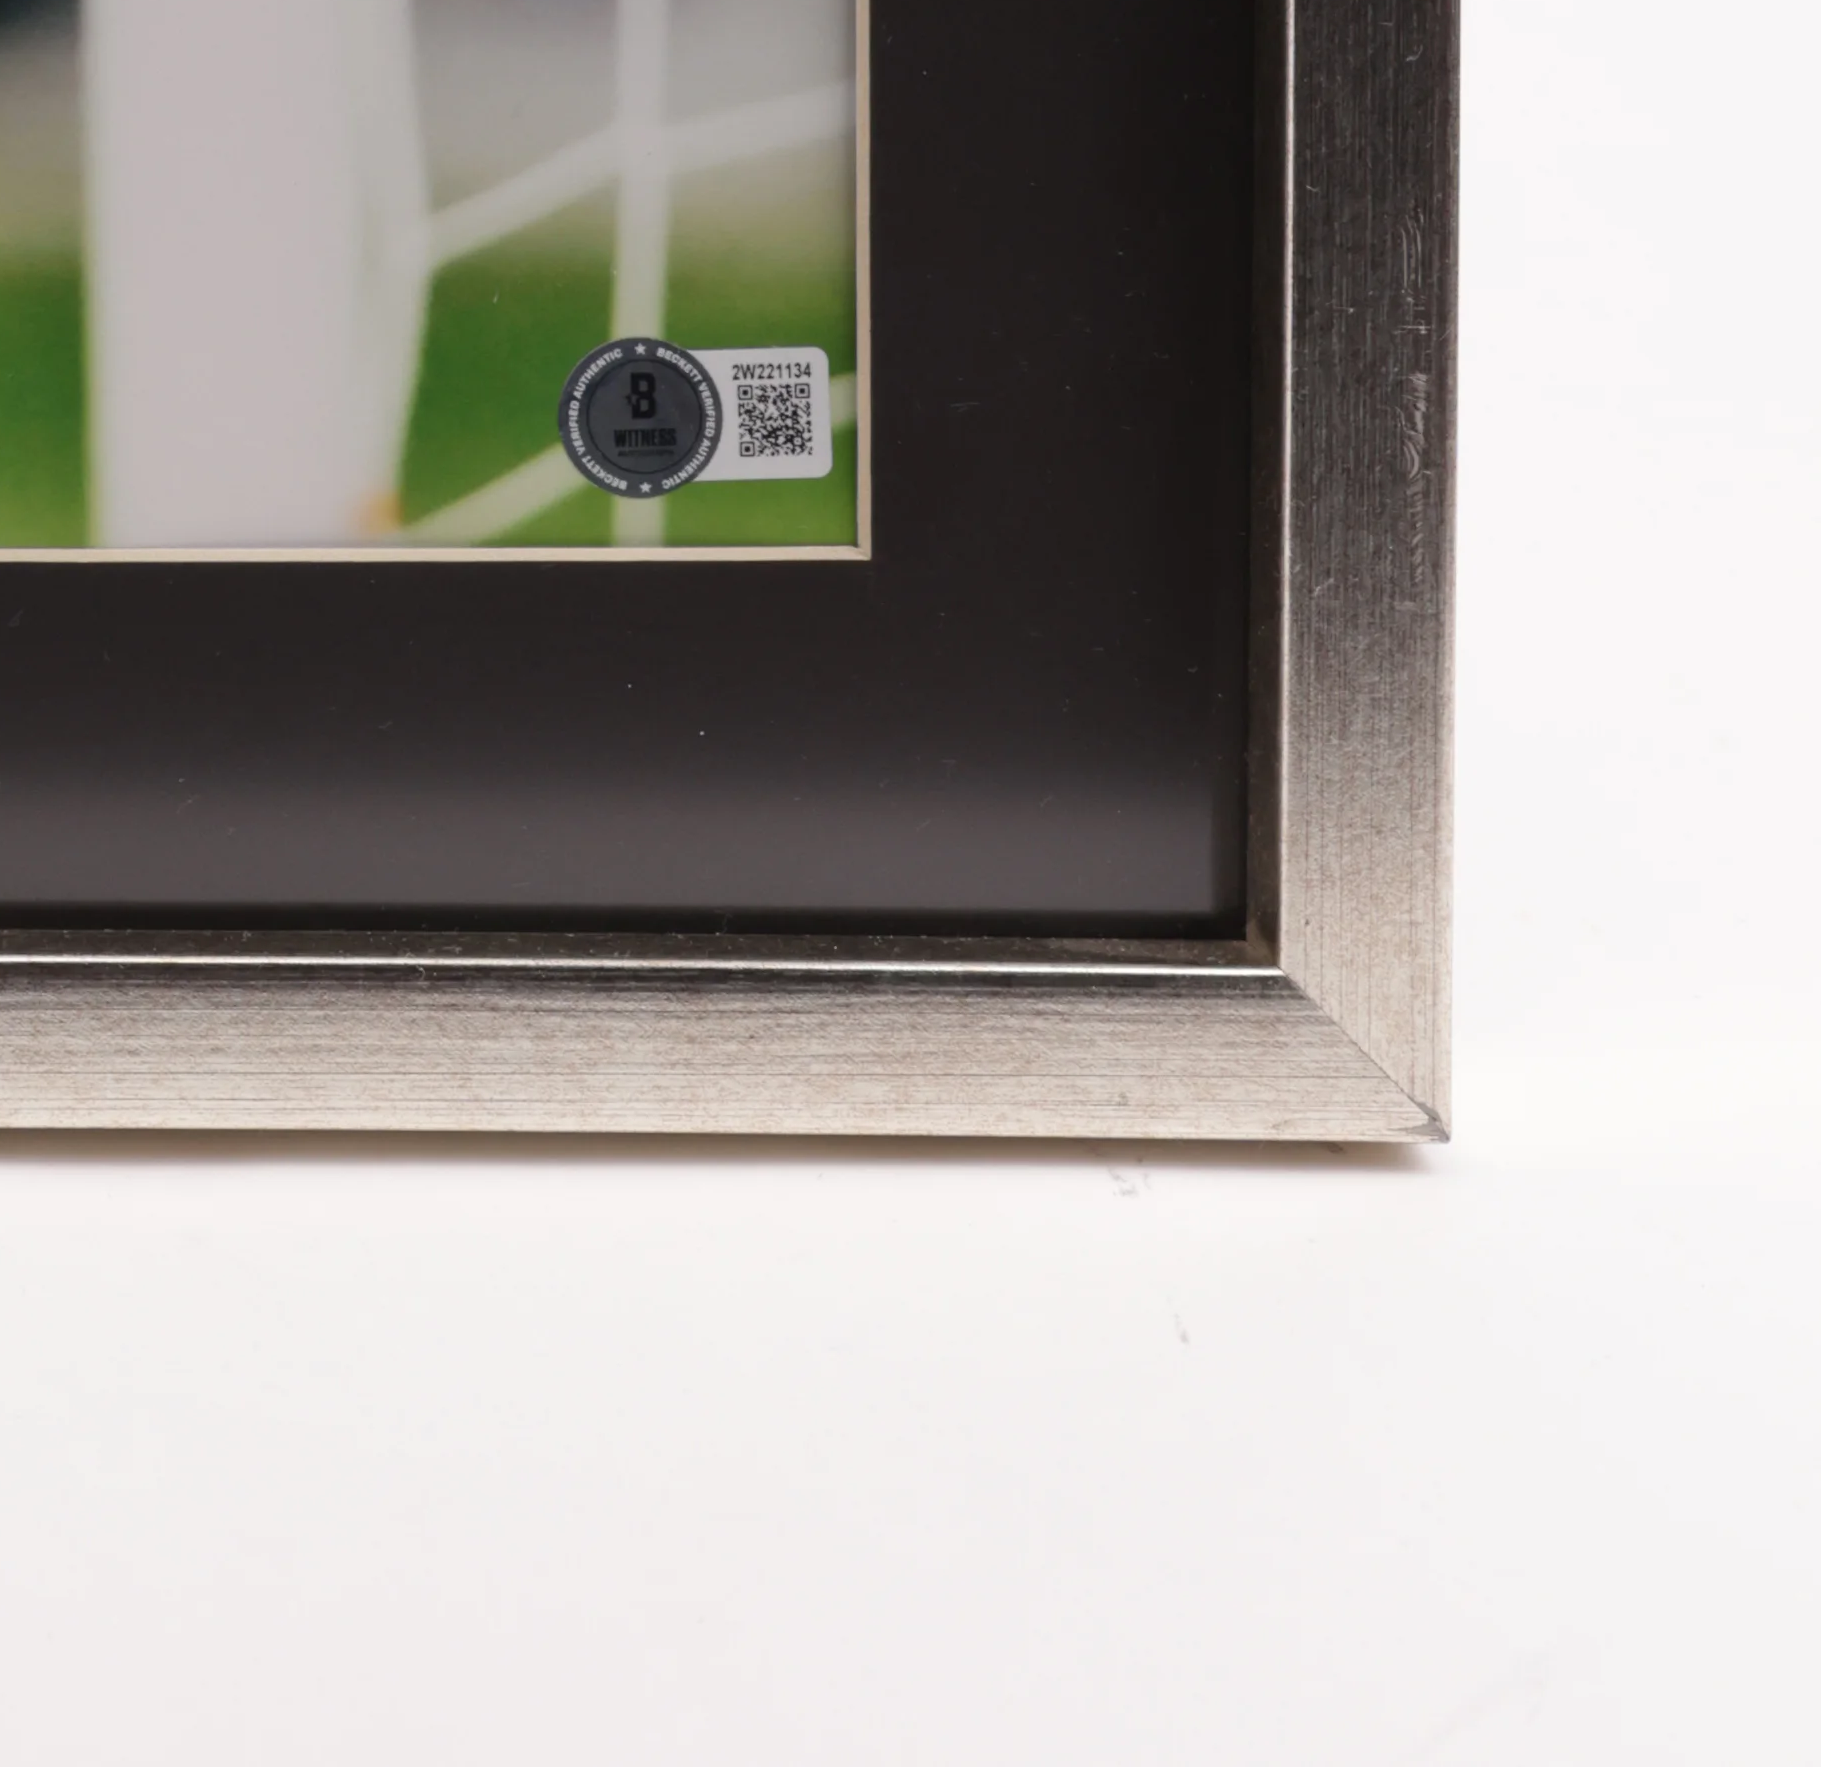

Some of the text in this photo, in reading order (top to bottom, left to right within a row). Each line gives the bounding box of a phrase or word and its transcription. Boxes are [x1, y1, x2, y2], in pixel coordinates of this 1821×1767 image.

[732, 362, 812, 382] 2W221134
[568, 348, 628, 491] BECKETT VERIFIED AUTHENTIC
[613, 428, 677, 448] WITNESS
[656, 347, 716, 490] BECKETT VERIFIED AUTHENTIC
